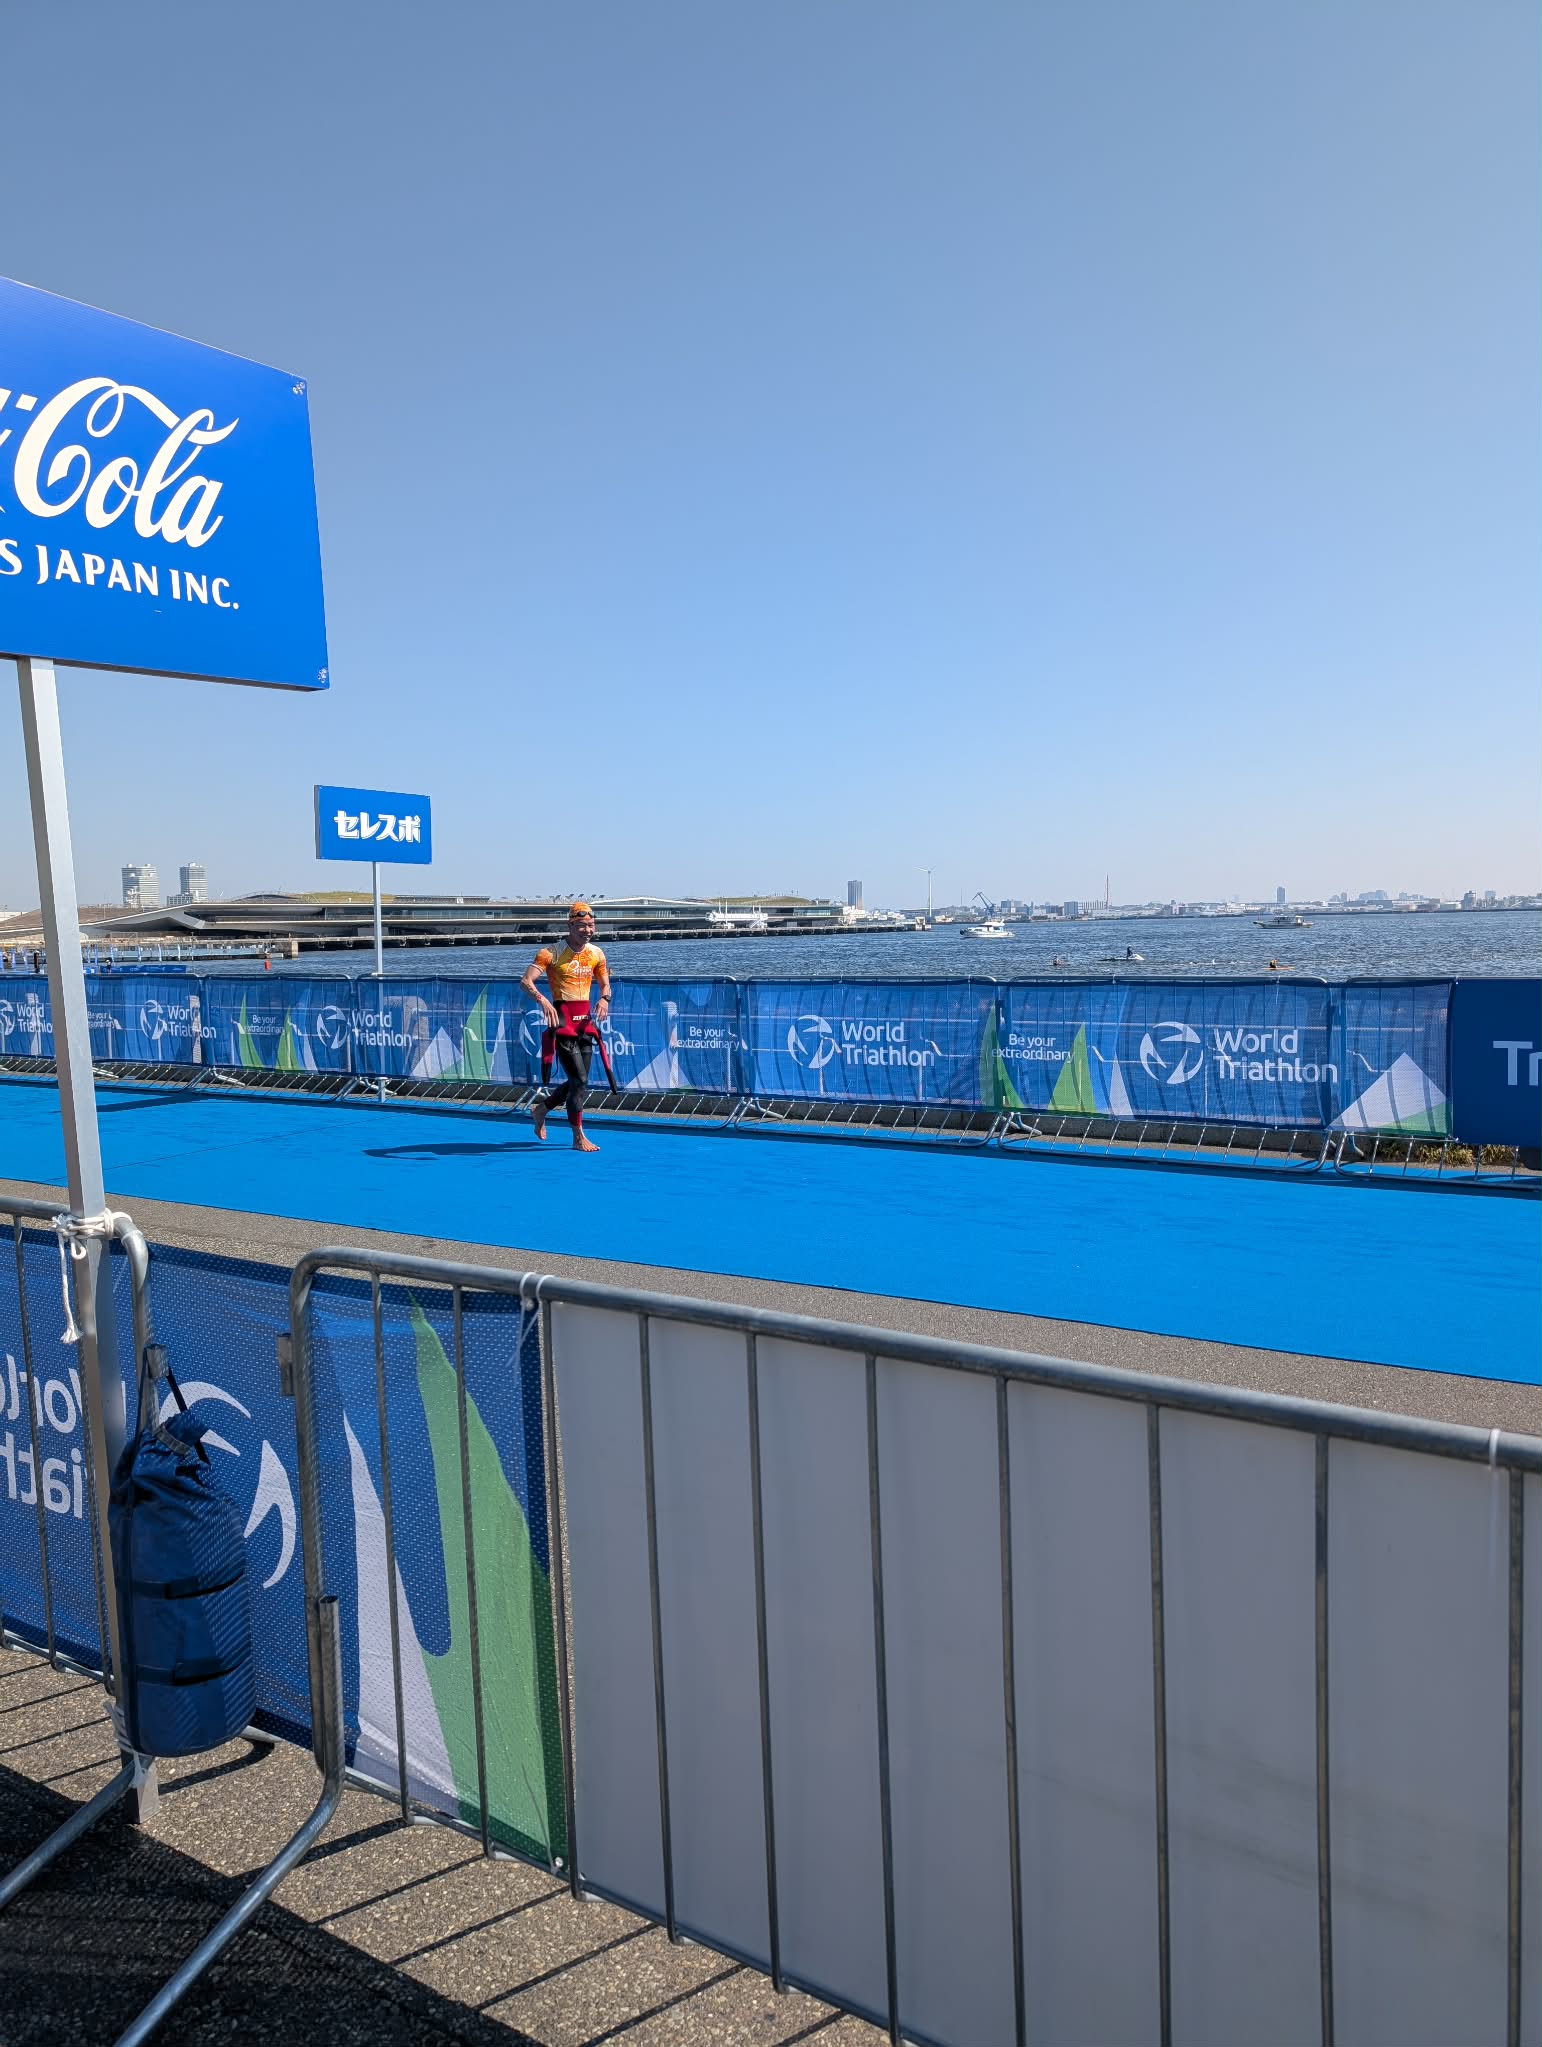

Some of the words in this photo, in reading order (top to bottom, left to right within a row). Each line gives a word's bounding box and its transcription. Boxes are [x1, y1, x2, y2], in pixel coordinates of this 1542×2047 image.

[36, 545, 159, 597] JAPAN
[169, 568, 240, 610] INC.
[333, 810, 421, 843] セレスポ
[17, 1018, 54, 1034] Triathlo
[252, 1014, 261, 1024] Be
[262, 1016, 276, 1025] your
[352, 1010, 392, 1027] World
[352, 1029, 412, 1047] Triathlon
[689, 1026, 702, 1037] Be
[704, 1028, 726, 1039] your
[842, 1020, 905, 1042] World
[677, 1037, 740, 1051] extraordinary
[1008, 1033, 1025, 1046] Be
[1026, 1037, 1056, 1049] your
[1213, 1028, 1299, 1054] World
[842, 1043, 935, 1067] Triathlon
[991, 1046, 1074, 1063] extraordinary
[1212, 1055, 1338, 1083] Triathlon
